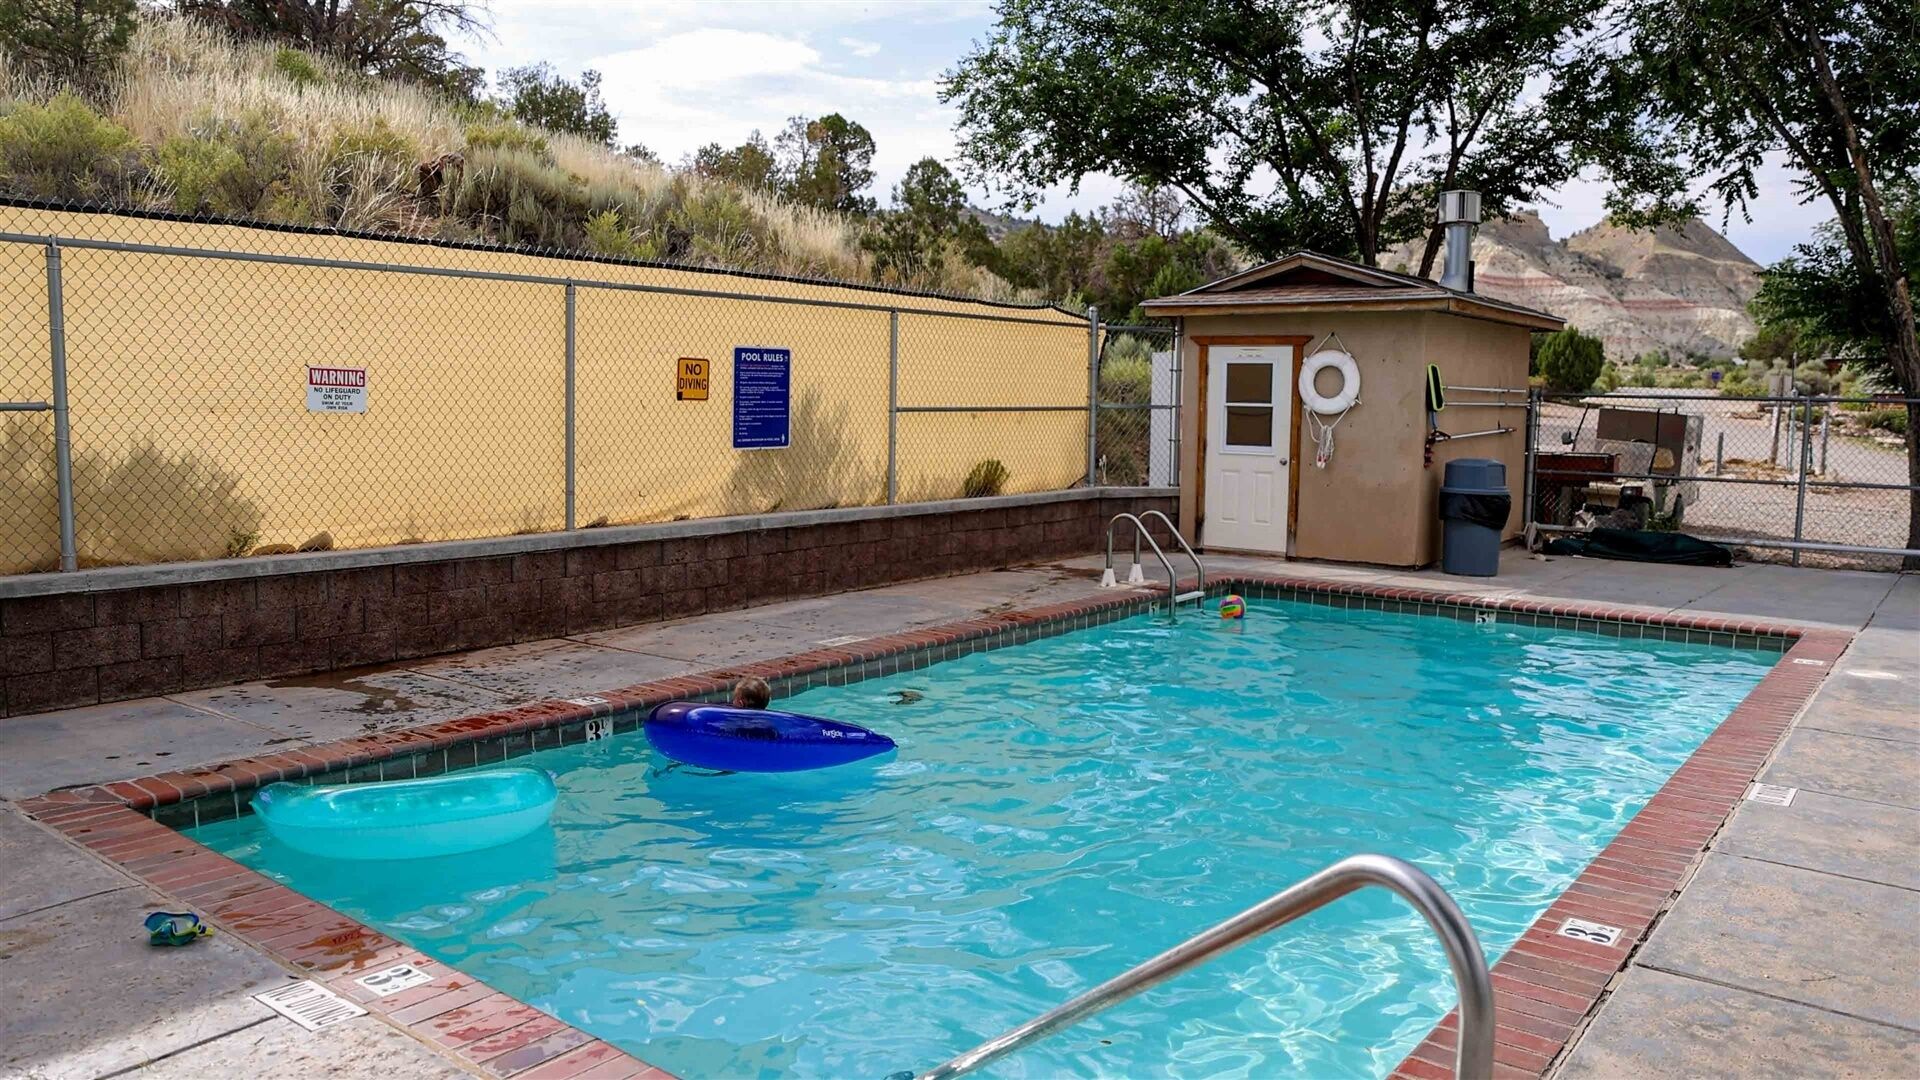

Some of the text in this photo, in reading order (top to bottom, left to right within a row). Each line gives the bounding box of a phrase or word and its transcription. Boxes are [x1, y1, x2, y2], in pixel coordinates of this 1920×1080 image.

[741, 352, 784, 362] POOL RULES
[685, 363, 702, 376] NO
[311, 369, 364, 386] WARNING
[679, 377, 707, 390] DIVING
[265, 983, 356, 1026] NO DIVING
